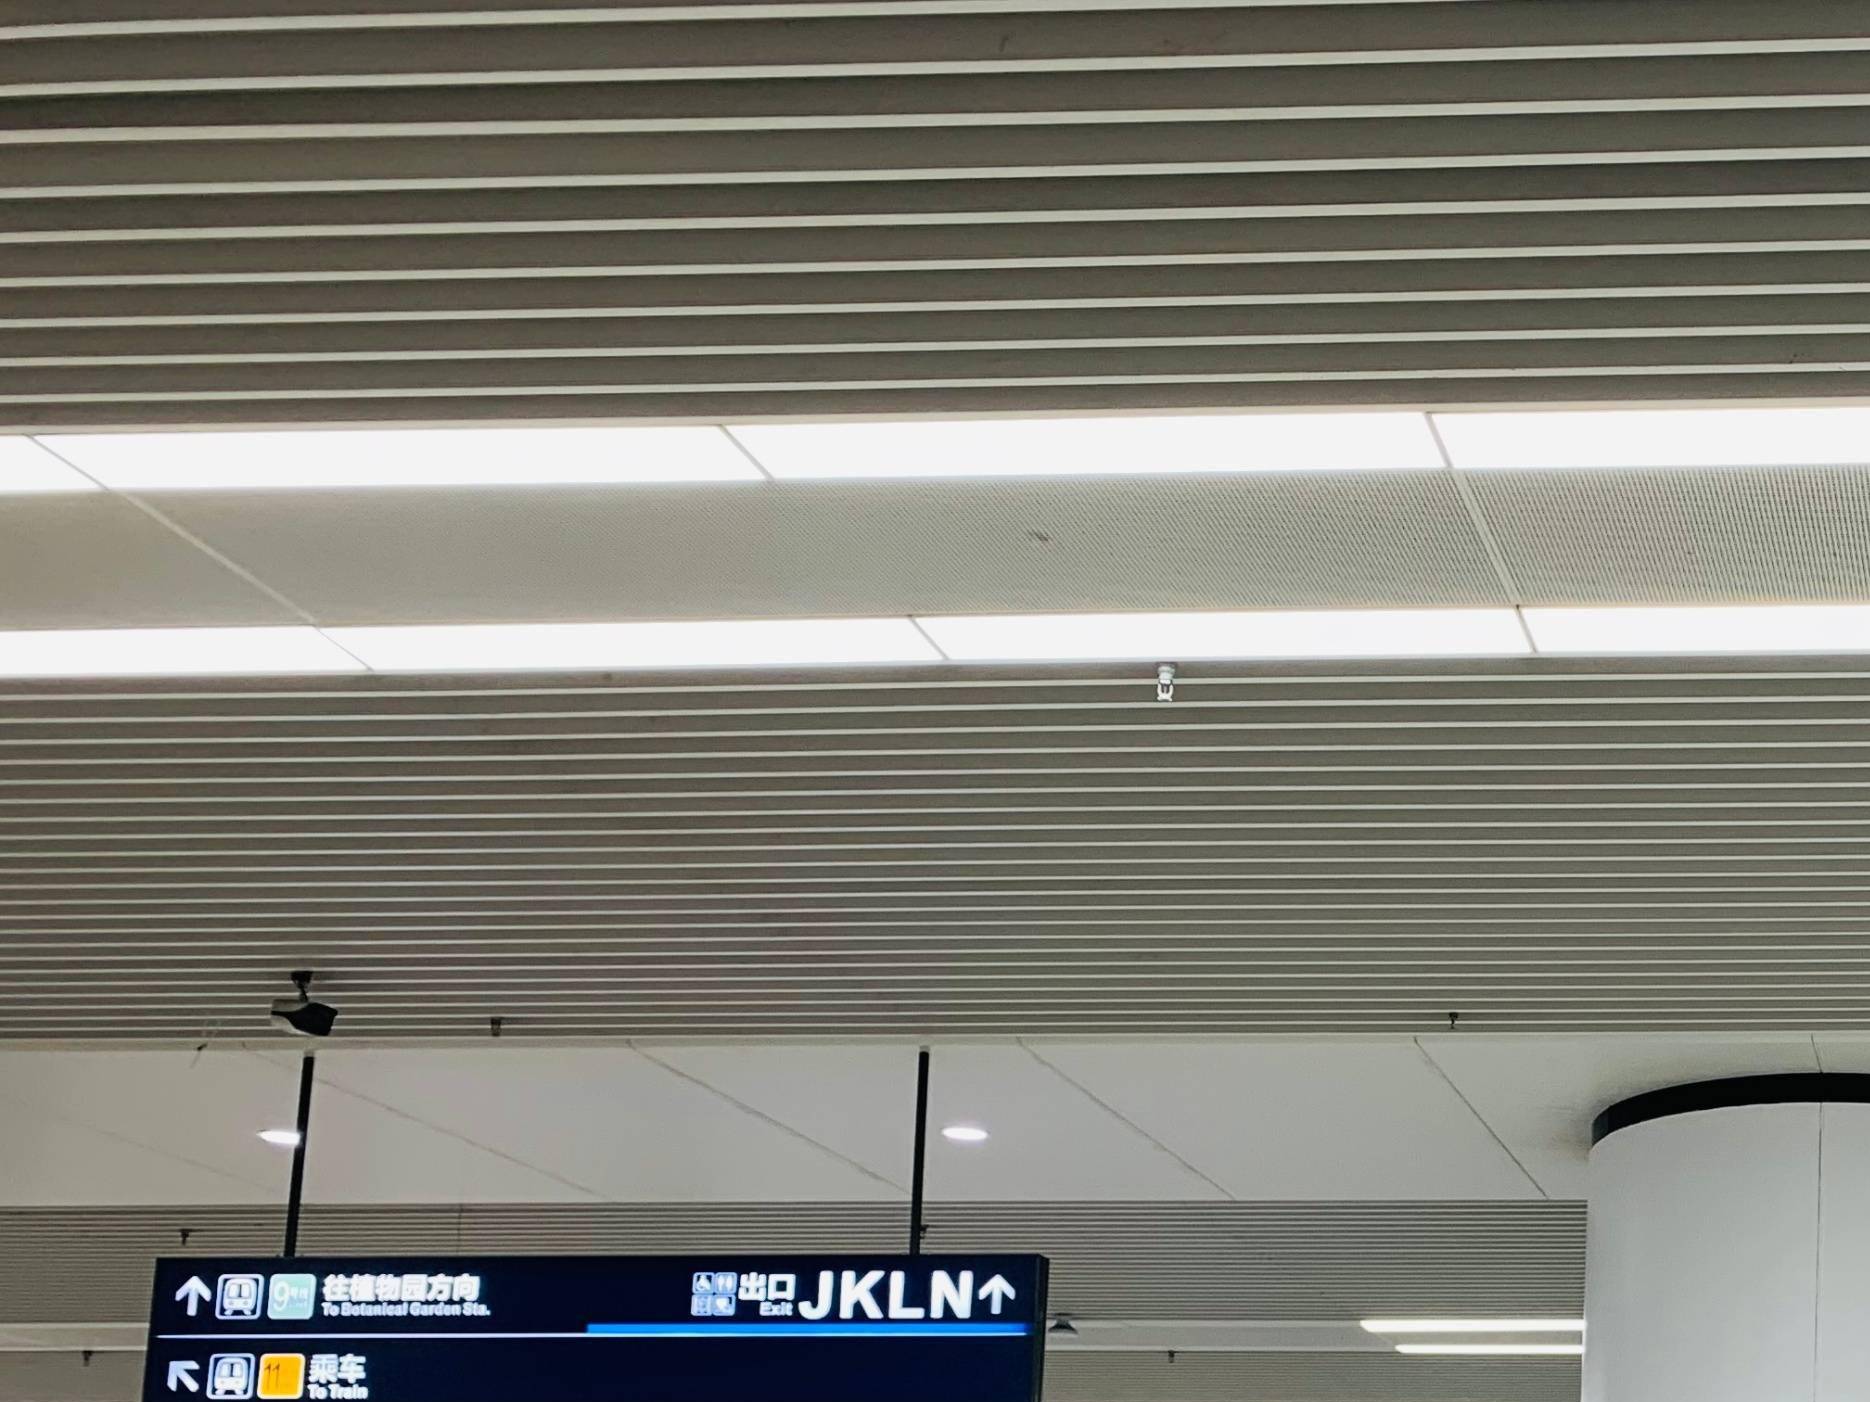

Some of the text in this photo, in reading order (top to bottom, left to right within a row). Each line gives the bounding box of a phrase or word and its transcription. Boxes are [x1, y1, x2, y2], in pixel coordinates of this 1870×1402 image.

[322, 1274, 481, 1301] 往植物园方向
[738, 1272, 796, 1301] 出口
[798, 1270, 974, 1320] JKLN
[321, 1302, 491, 1316] To Botanical Garden Sta.
[759, 1301, 793, 1316] Exit
[264, 1361, 280, 1390] 11
[308, 1353, 366, 1383] 乘车
[307, 1383, 369, 1400] To Train
